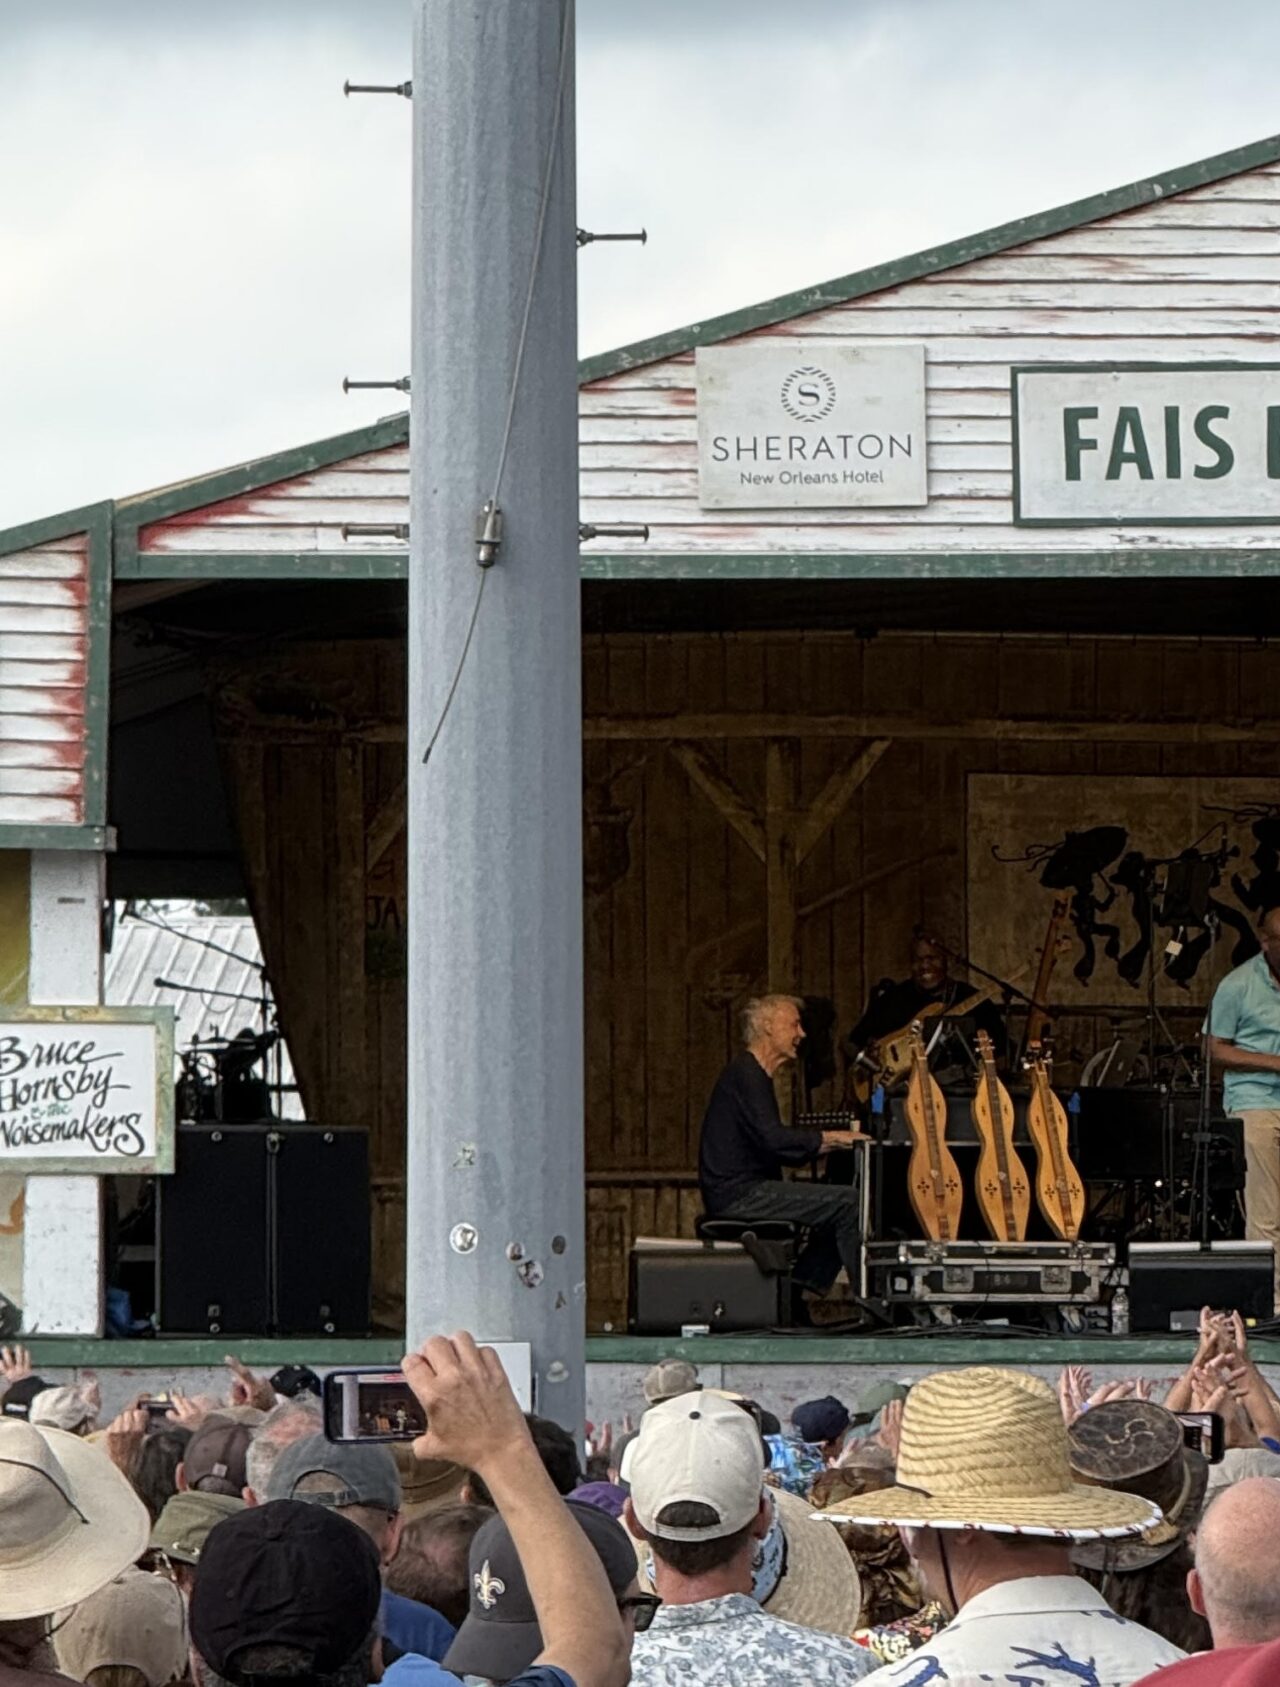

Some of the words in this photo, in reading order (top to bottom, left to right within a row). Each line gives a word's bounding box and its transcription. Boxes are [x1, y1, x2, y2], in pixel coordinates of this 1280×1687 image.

[712, 434, 912, 462] SHERATON
[1062, 405, 1235, 481] FAIS
[740, 472, 774, 486] New
[779, 470, 838, 485] Orleans
[842, 470, 884, 484] Hotel
[0, 1036, 124, 1076] Bruce
[0, 1064, 131, 1113] Hornsby
[0, 1106, 145, 1157] Noisemakers
